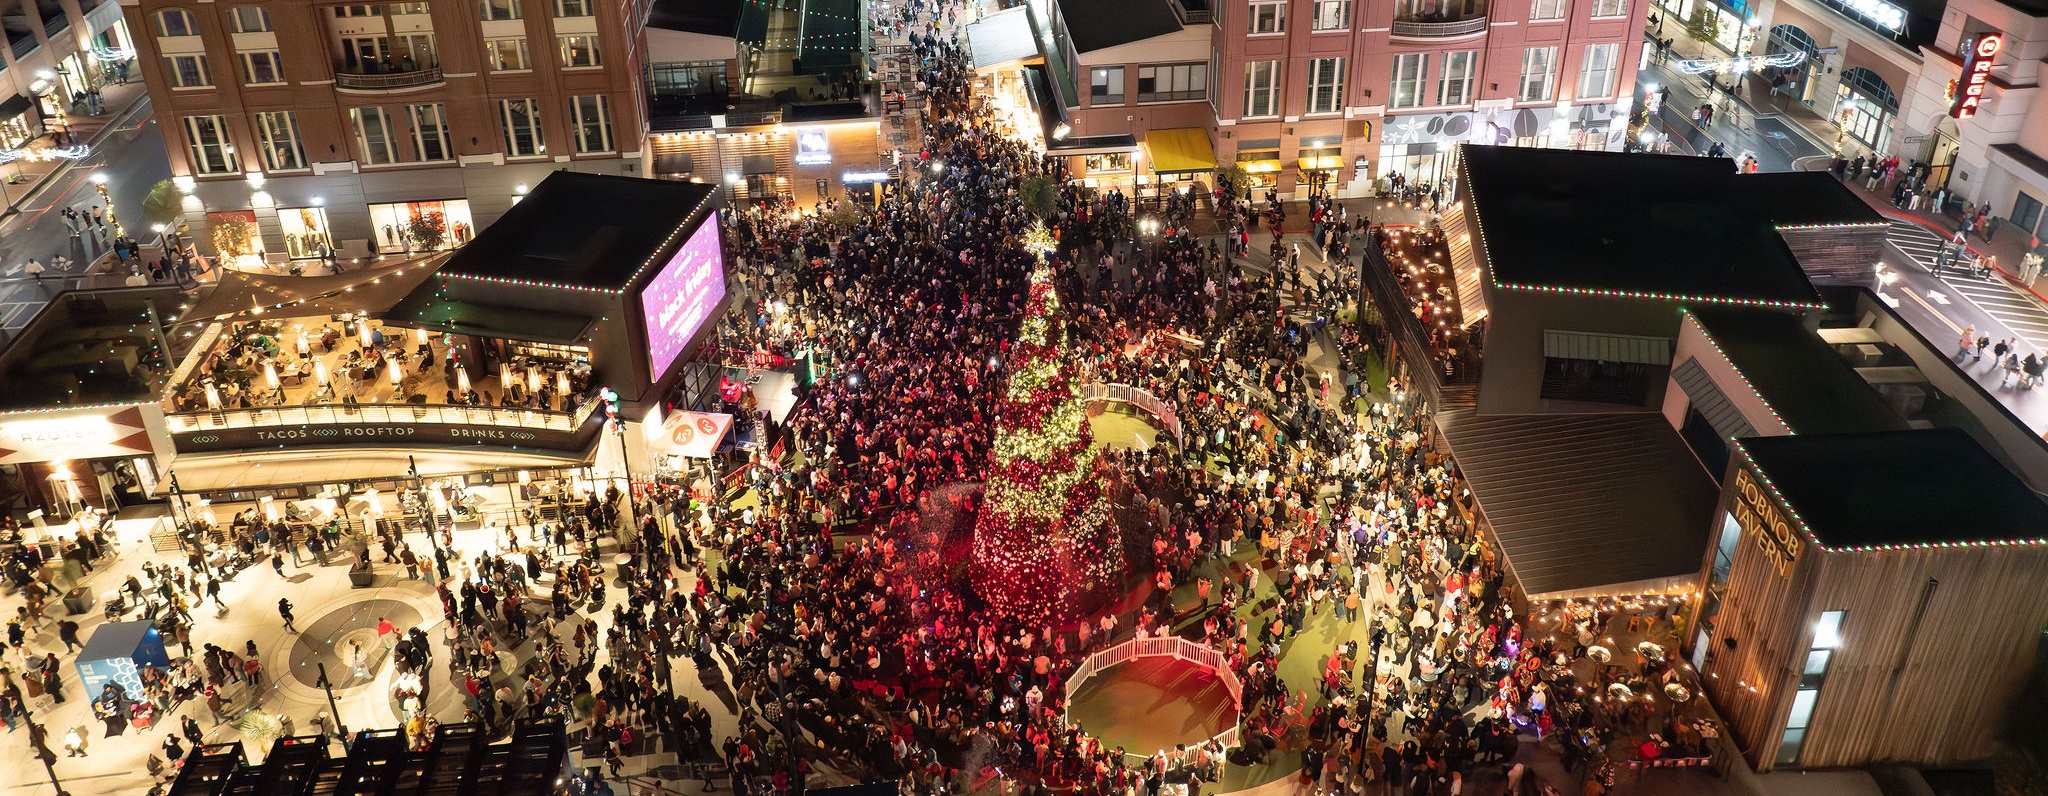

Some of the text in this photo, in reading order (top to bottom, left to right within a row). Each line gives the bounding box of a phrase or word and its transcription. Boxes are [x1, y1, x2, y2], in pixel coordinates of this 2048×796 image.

[1959, 61, 1992, 118] REGAL
[658, 289, 685, 329] black
[685, 258, 711, 297] friday
[257, 427, 505, 440] TACOS ROOFTOP DRINKS
[1736, 467, 1799, 557] HOBNOB
[1736, 496, 1788, 577] TAVERN
